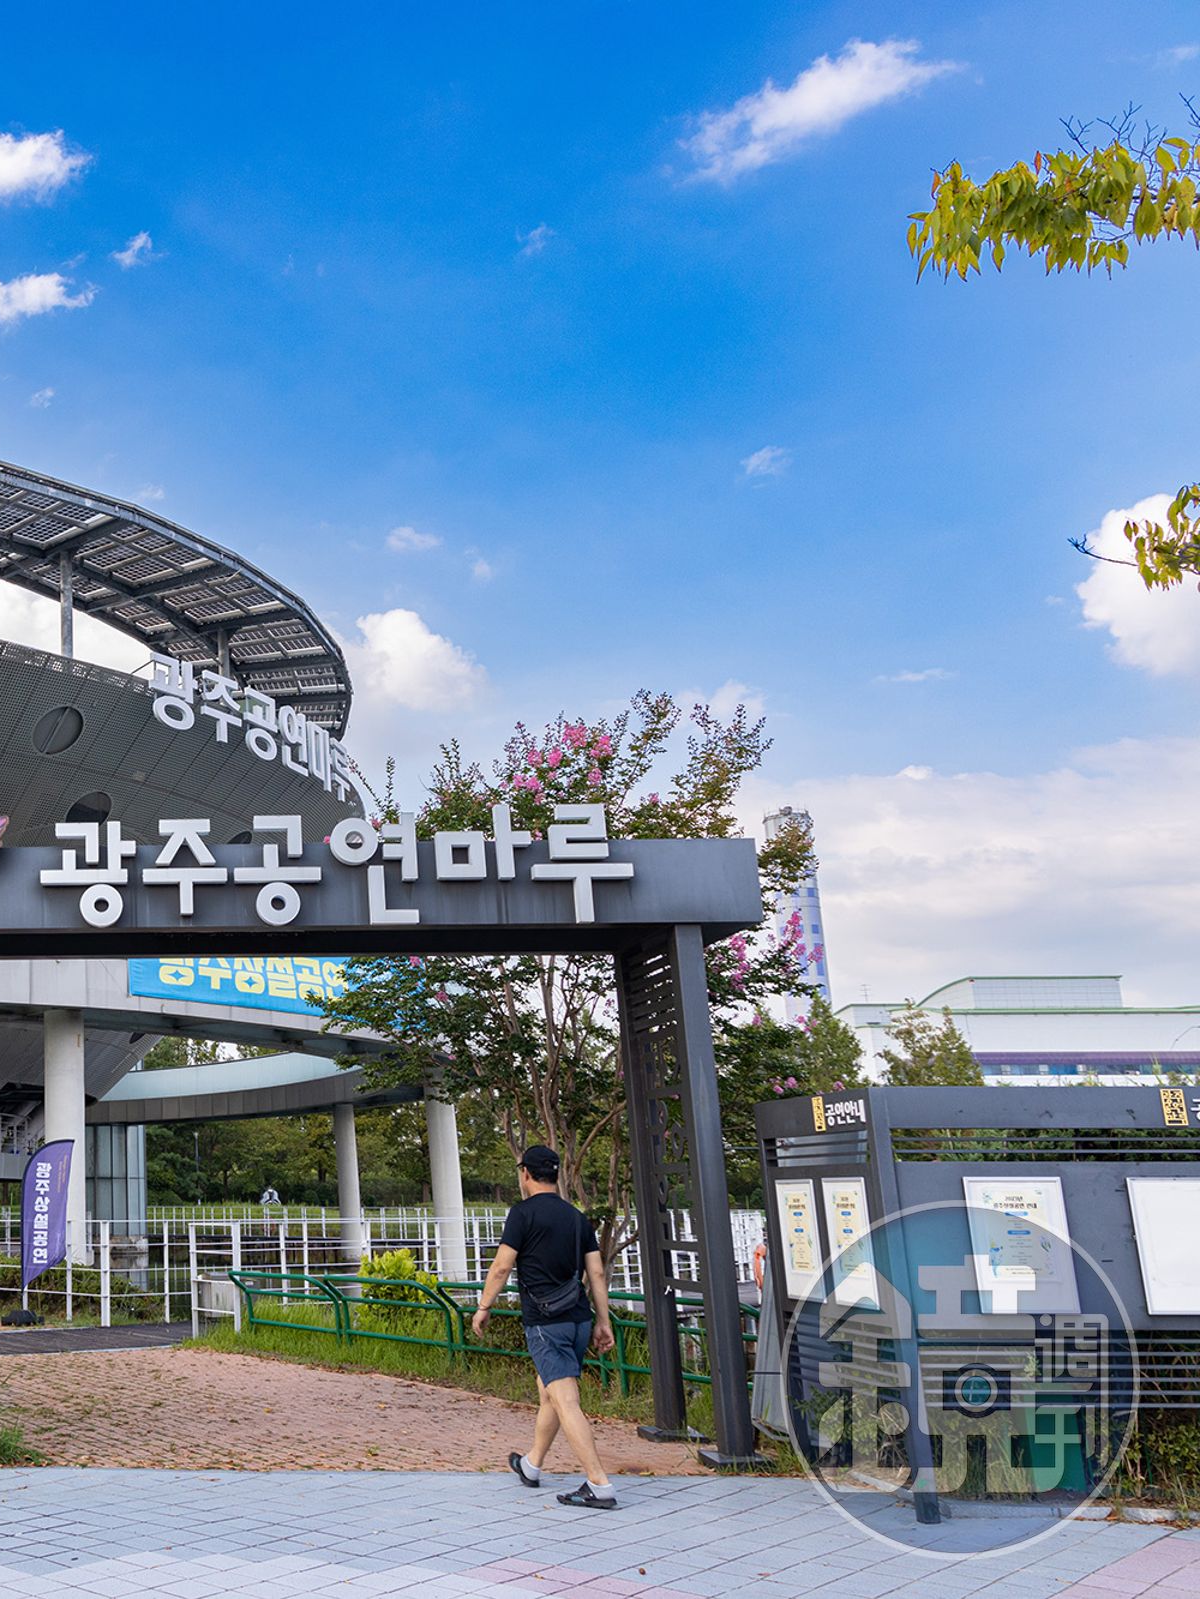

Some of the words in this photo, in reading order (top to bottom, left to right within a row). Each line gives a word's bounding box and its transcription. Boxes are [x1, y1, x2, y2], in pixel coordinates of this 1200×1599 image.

[149, 651, 351, 802] 광주공연마루
[40, 803, 634, 928] 광주공연마루
[825, 1099, 866, 1127] 공연안내
[33, 1162, 52, 1264] 광주상설공연
